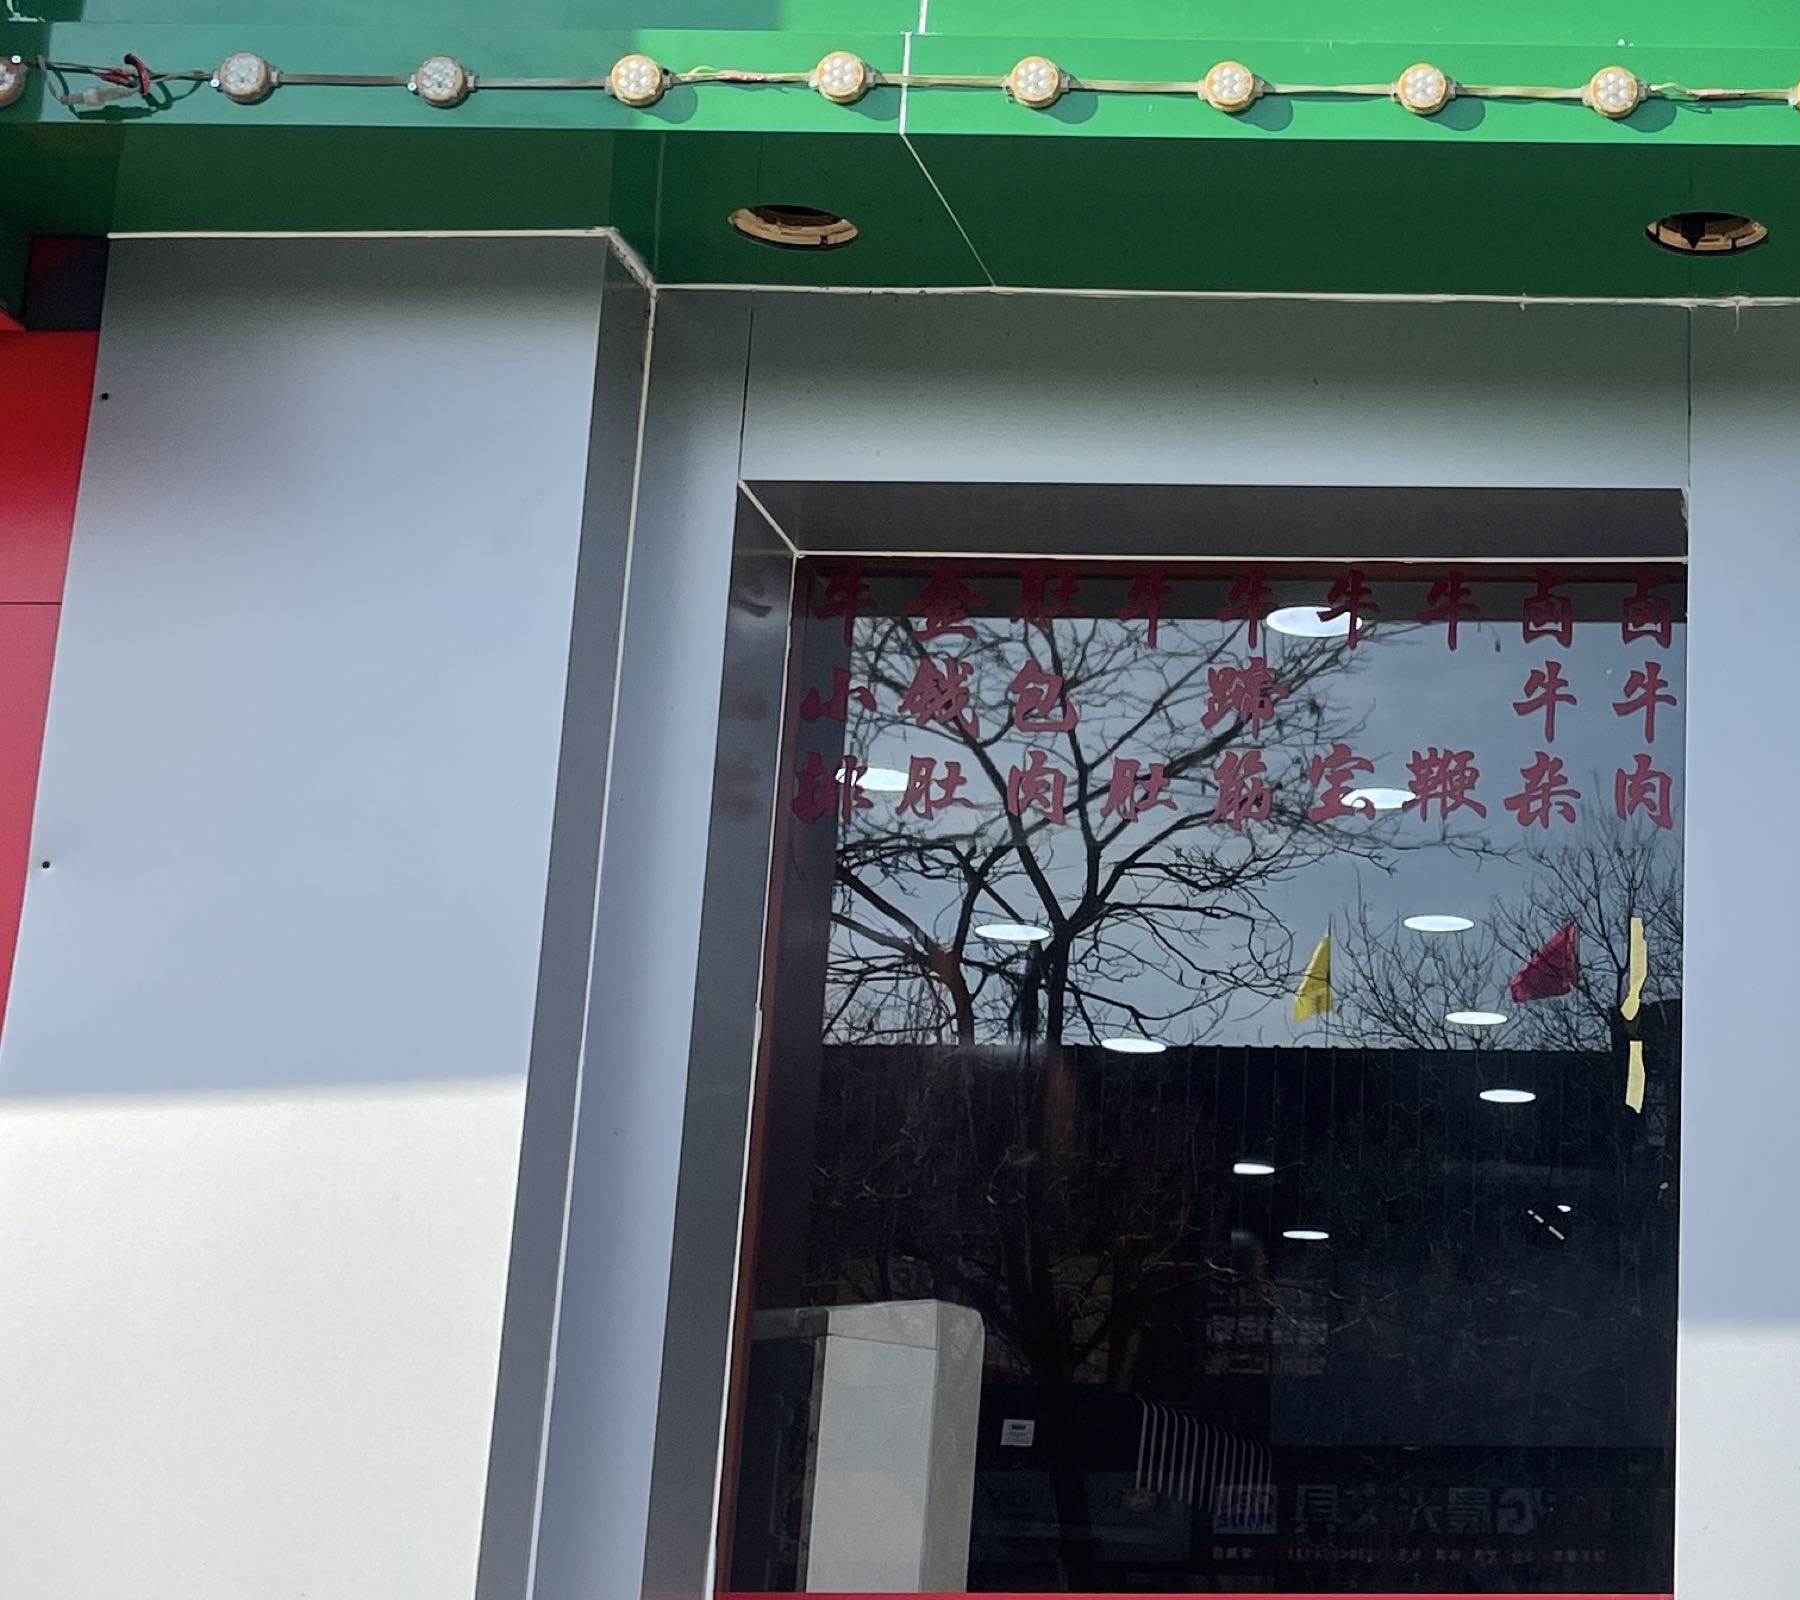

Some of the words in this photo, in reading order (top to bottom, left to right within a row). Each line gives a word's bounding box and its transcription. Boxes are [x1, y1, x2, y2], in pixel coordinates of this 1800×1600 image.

[897, 564, 991, 820] 金钱肚
[1008, 565, 1083, 825] 肚包肉
[1200, 568, 1290, 830] 牛蹄筋
[1308, 568, 1380, 824] 牛宝
[1402, 568, 1487, 822] 牛鞭
[1504, 567, 1581, 829] 卤牛杂
[1612, 567, 1678, 829] 卤牛肉
